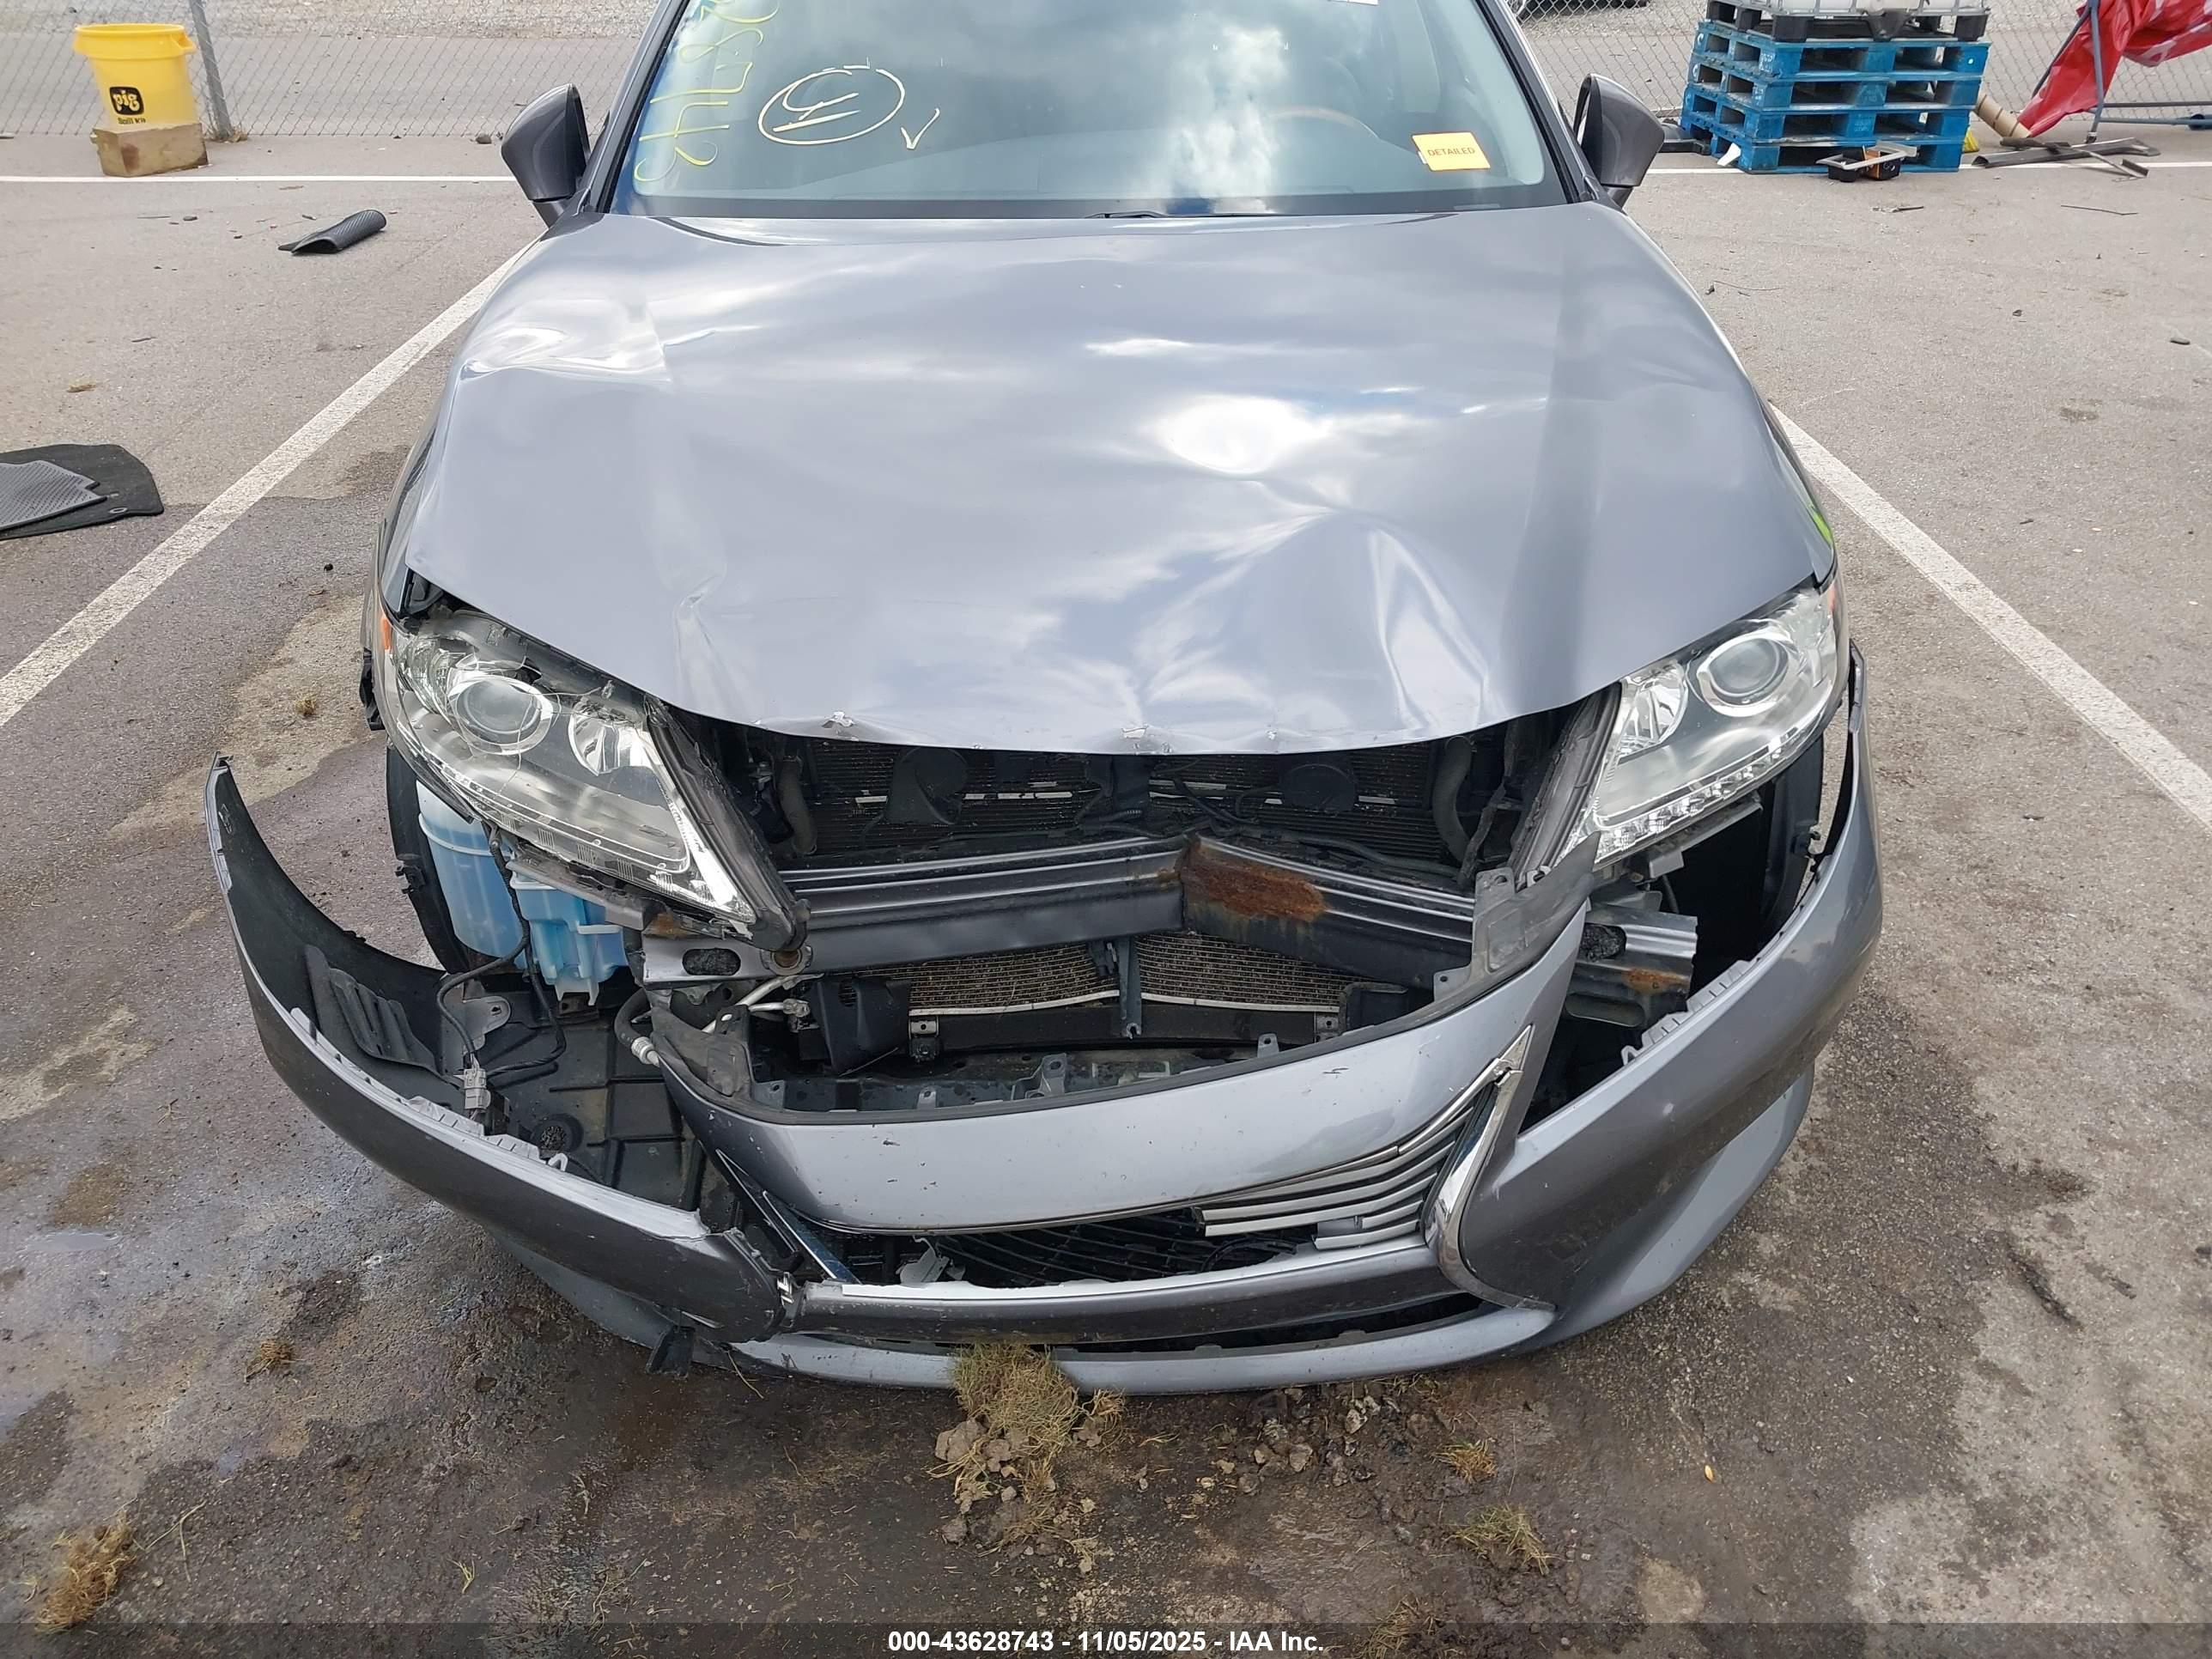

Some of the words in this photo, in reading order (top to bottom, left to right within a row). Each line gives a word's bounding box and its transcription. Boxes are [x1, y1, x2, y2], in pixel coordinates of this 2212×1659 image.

[112, 89, 140, 112] pig
[634, 0, 780, 182] 28743
[1427, 147, 1476, 156] DETAILED
